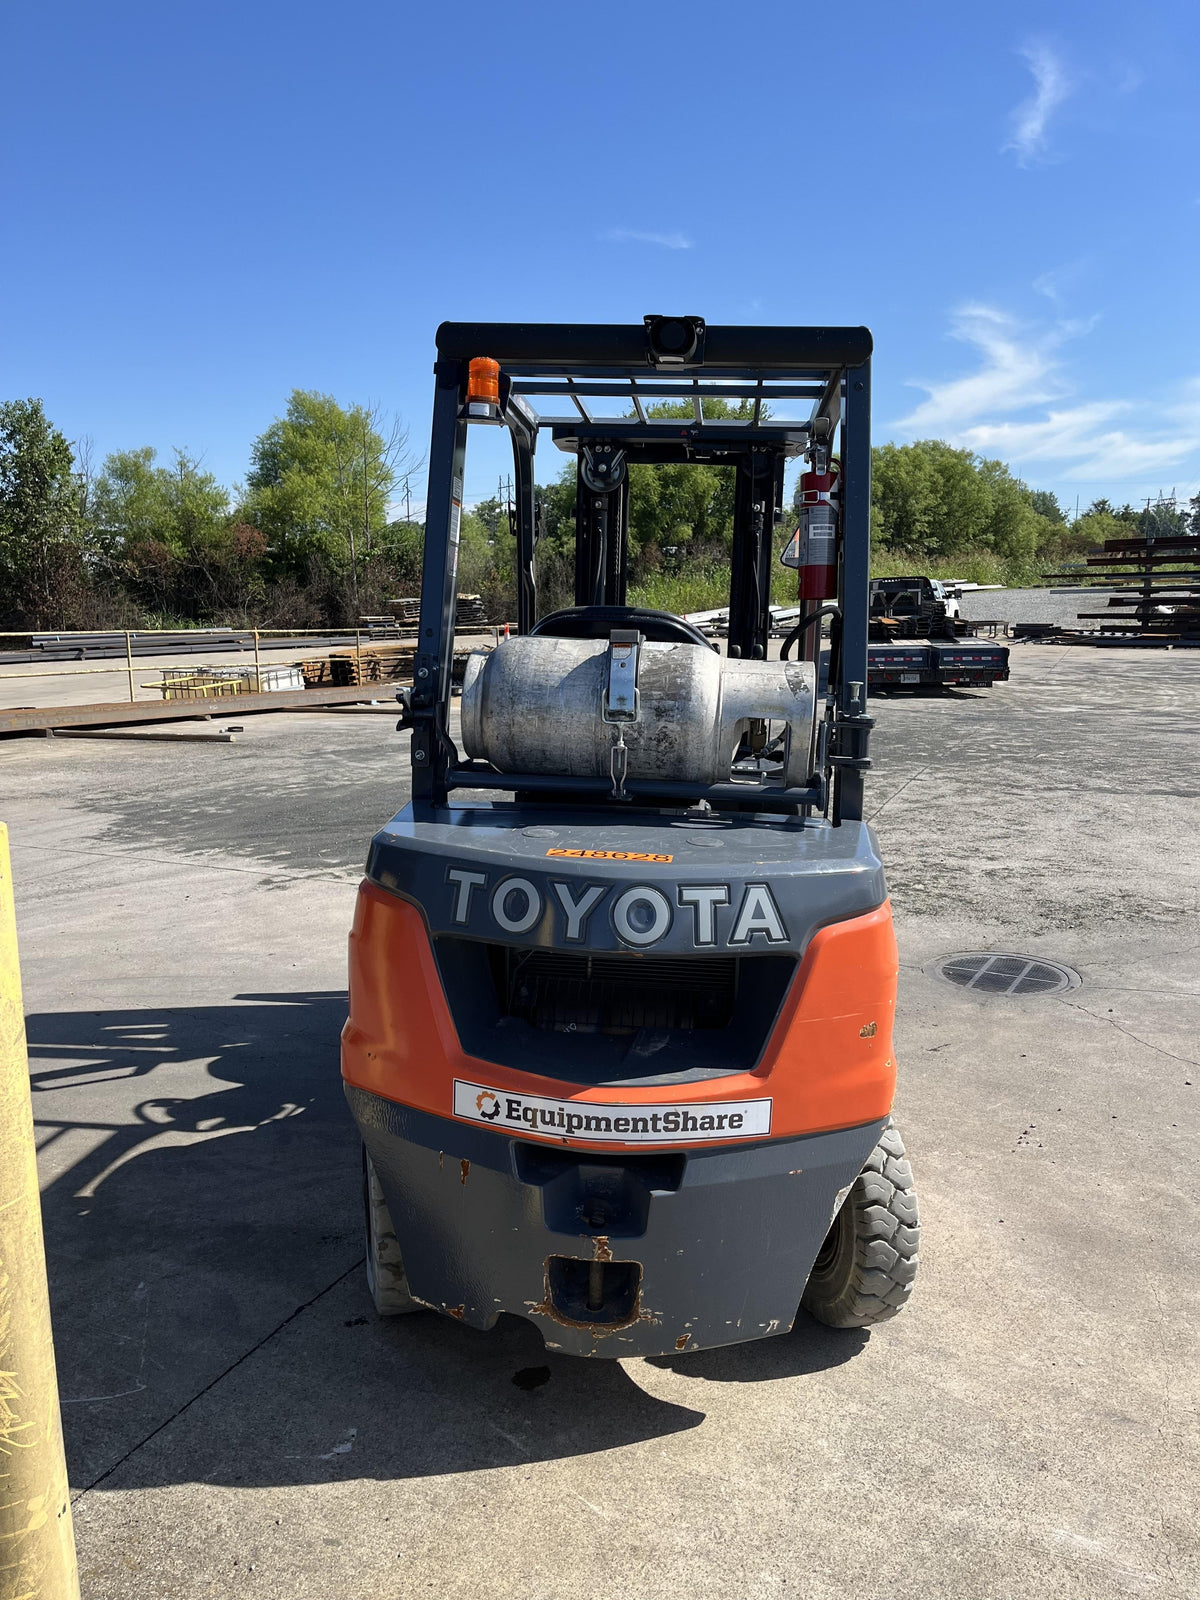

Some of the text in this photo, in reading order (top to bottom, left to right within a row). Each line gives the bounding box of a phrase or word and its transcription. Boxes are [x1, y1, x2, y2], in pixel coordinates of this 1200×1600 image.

[550, 848, 670, 862] 248628
[448, 869, 788, 946] TOYOTA
[505, 1098, 744, 1134] EquipmentShare
